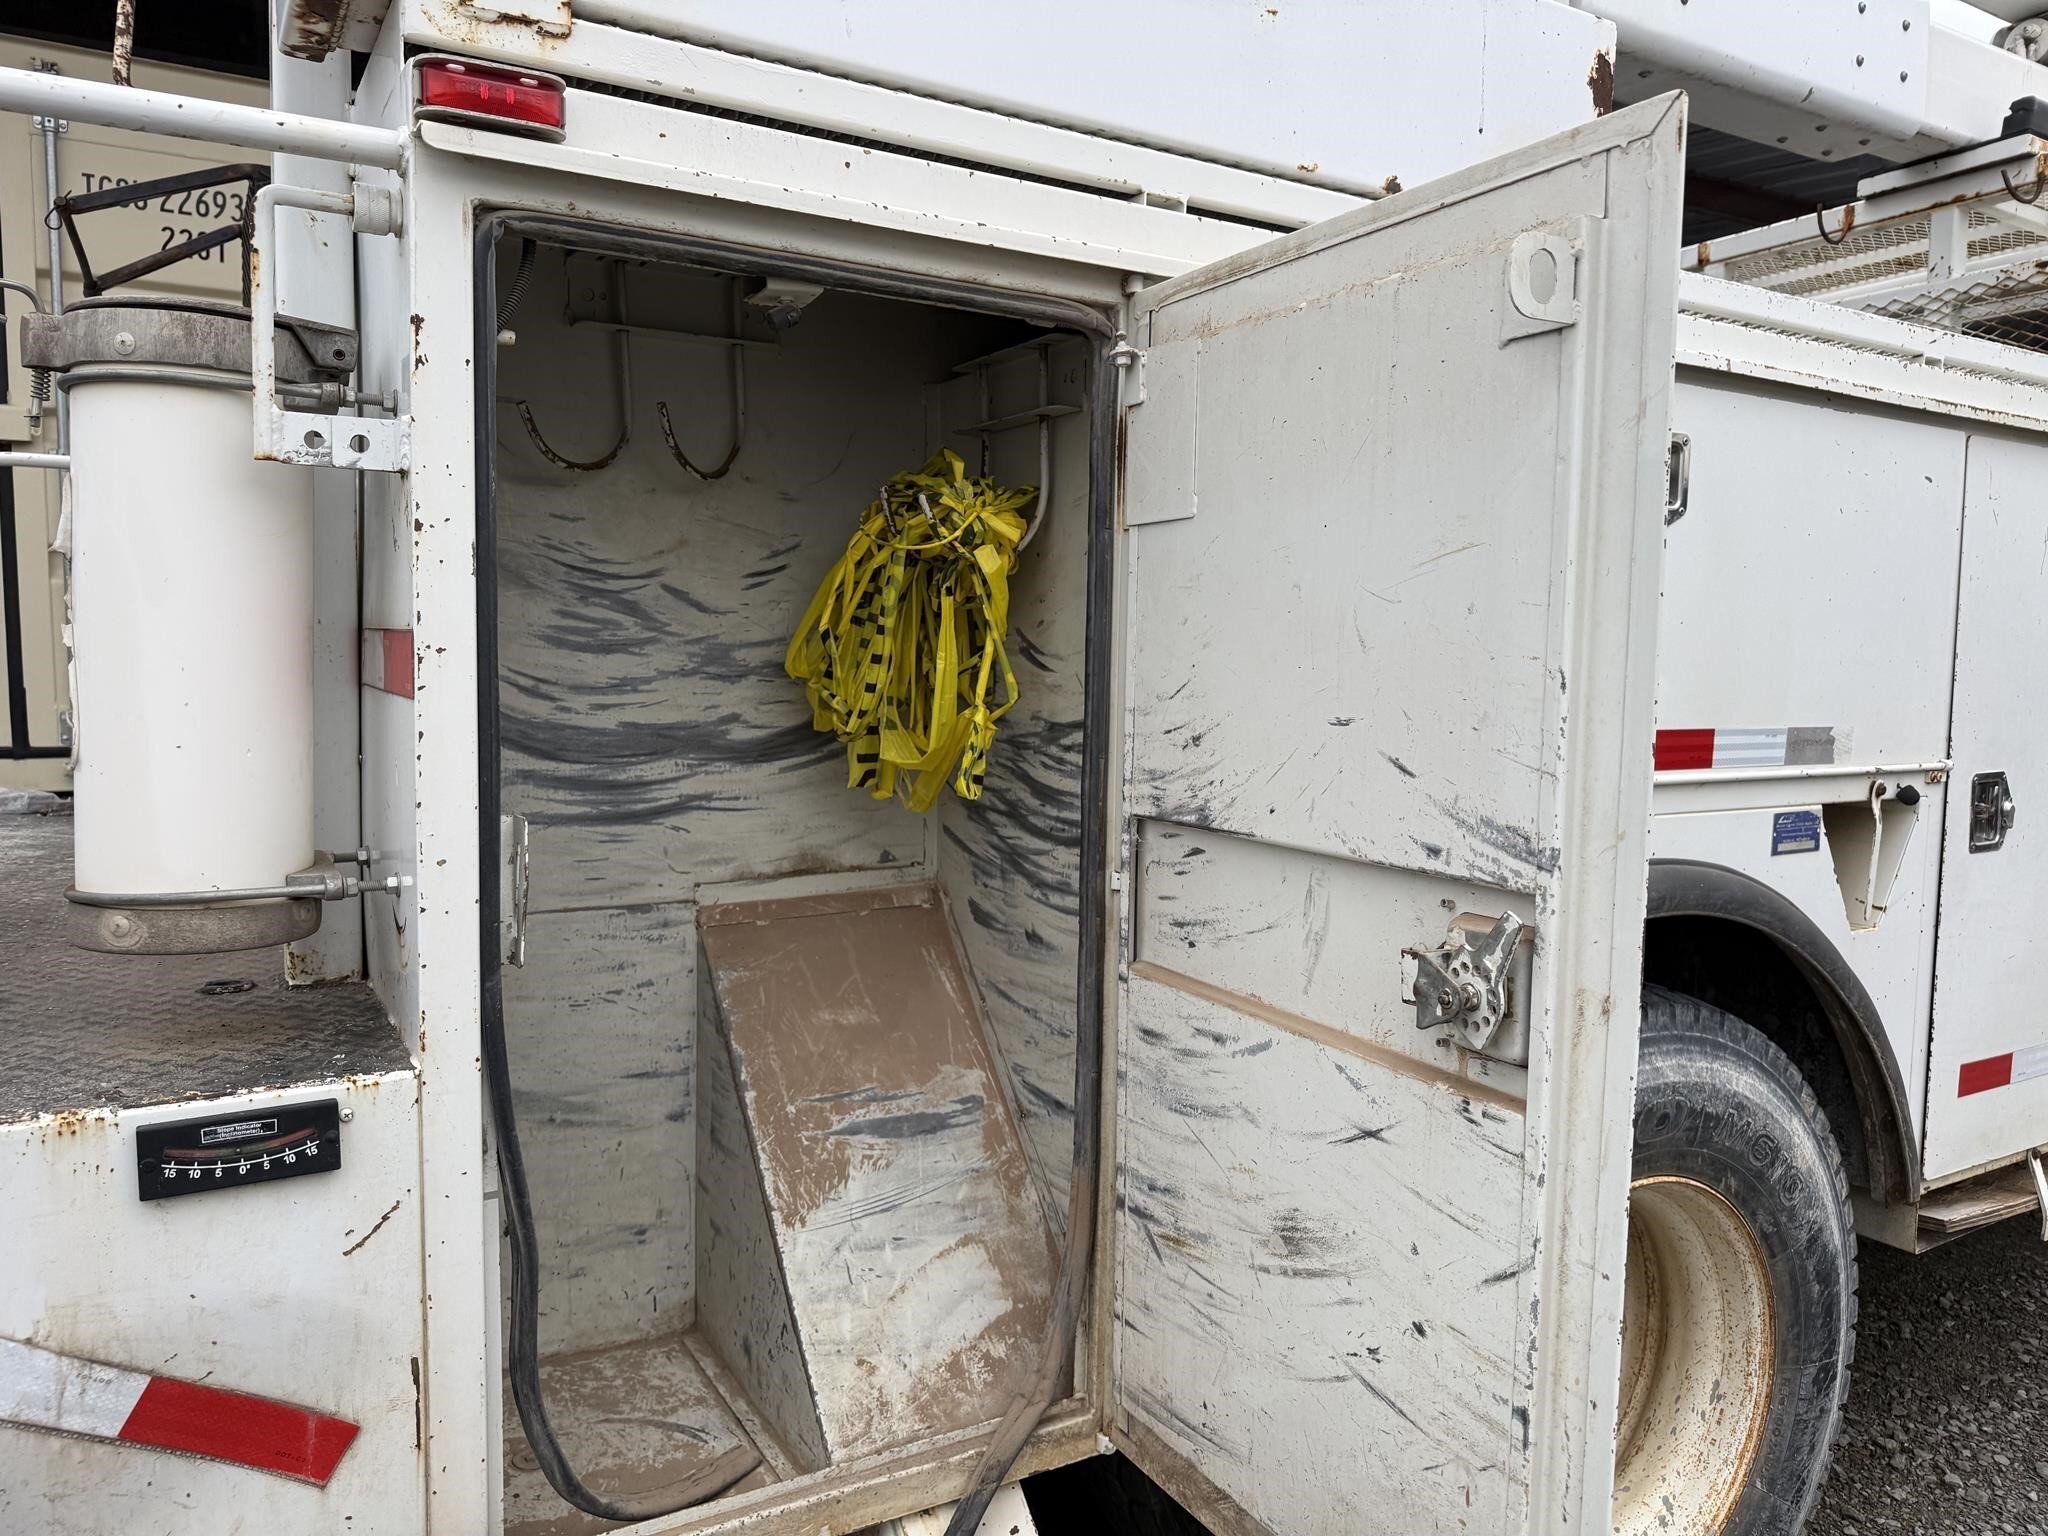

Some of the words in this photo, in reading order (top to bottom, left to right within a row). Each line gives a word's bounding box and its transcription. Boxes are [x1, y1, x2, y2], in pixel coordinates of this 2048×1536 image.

[235, 1122, 262, 1131] Indicator
[163, 1168, 177, 1178] 15
[188, 1169, 201, 1179] 10
[215, 1168, 223, 1178] 5
[263, 1160, 271, 1170] 5
[283, 1153, 296, 1164] 10
[304, 1145, 319, 1157] 15
[1712, 1108, 1806, 1207] M610
